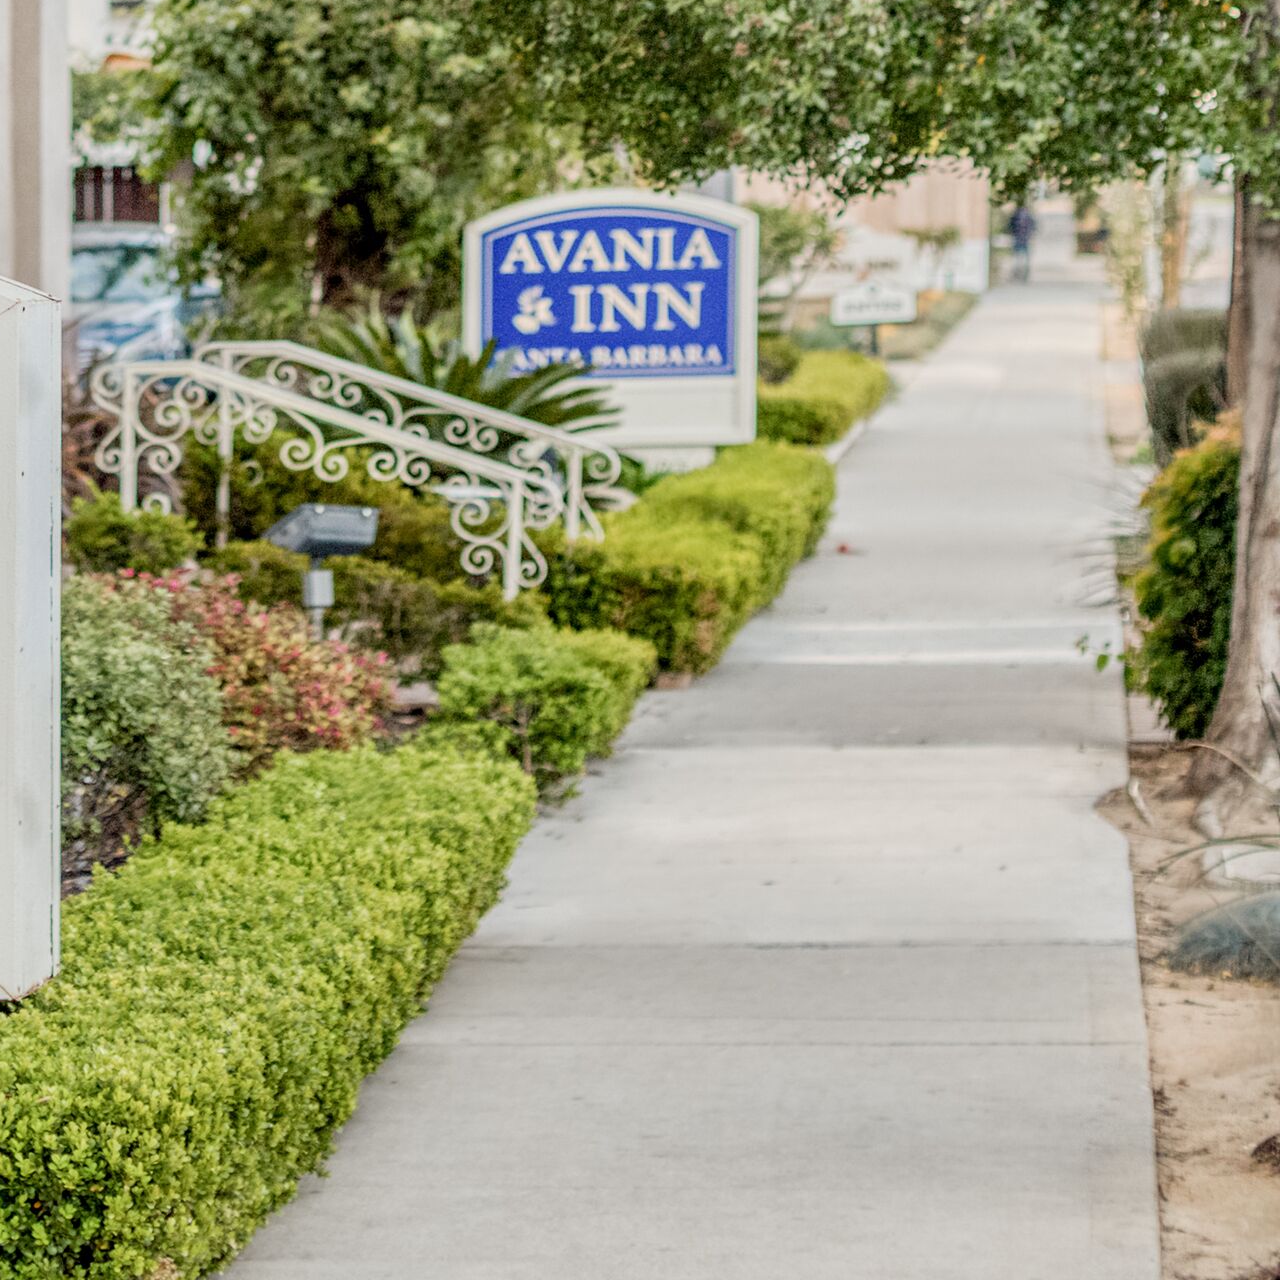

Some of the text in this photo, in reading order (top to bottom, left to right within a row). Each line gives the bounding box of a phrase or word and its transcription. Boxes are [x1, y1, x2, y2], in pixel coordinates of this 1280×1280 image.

[500, 227, 721, 274] AVANIA
[568, 282, 705, 333] INN
[590, 343, 723, 368] BARBARA
